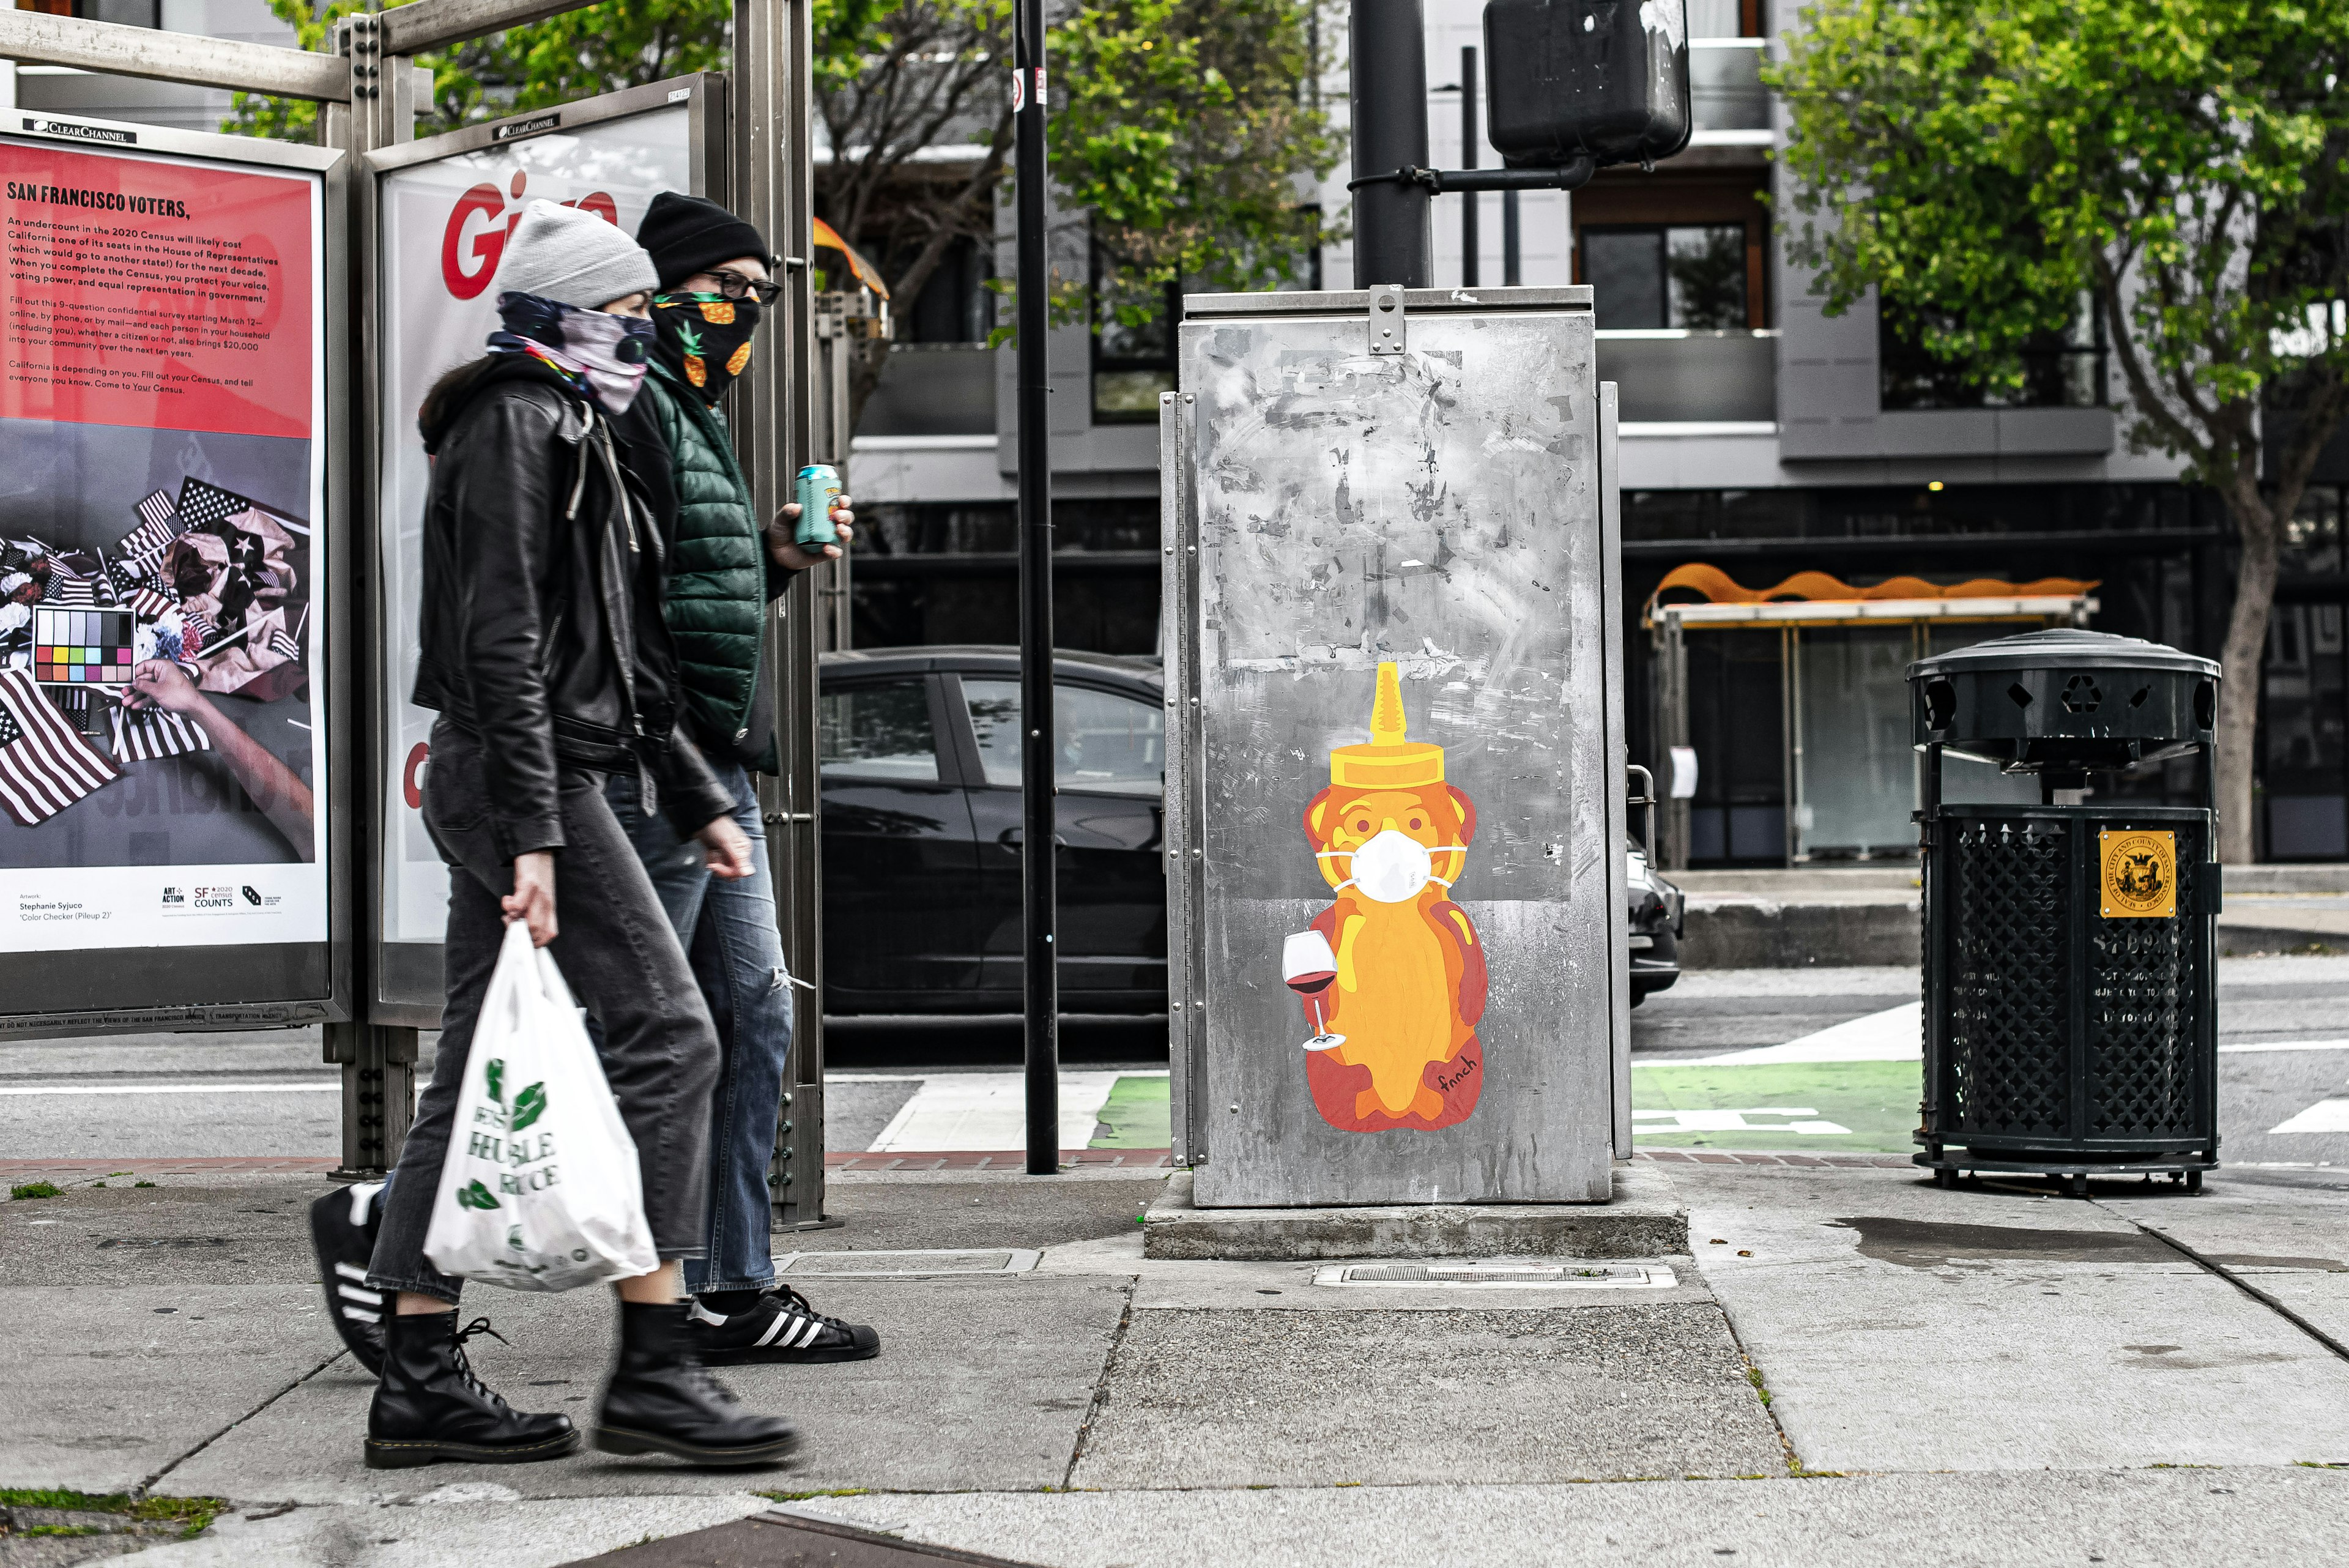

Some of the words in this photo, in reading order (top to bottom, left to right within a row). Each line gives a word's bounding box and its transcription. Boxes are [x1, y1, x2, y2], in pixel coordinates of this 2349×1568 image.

[7, 182, 36, 202] SAN
[41, 185, 125, 211] FRANCISCO
[129, 195, 190, 221] VOTERS,
[7, 216, 20, 225] An
[24, 220, 79, 231] undercount
[82, 224, 90, 232] in
[94, 226, 109, 234] the
[112, 228, 138, 237] 2020
[141, 231, 174, 241] Census
[177, 235, 193, 243] will
[196, 236, 219, 248] likely
[8, 230, 55, 242] California
[92, 238, 103, 247] its
[133, 243, 141, 251] in
[145, 244, 160, 253] the
[163, 246, 191, 256] House
[194, 249, 203, 257] of
[206, 251, 278, 265] Representatives
[8, 243, 40, 254] (which
[43, 249, 72, 257] would
[76, 252, 87, 260] go
[103, 255, 139, 264] another
[142, 258, 172, 268] state!)
[175, 260, 188, 269] for
[191, 262, 206, 271] the
[230, 266, 265, 276] decade.
[9, 257, 37, 266] When
[60, 264, 105, 274] complete
[108, 267, 123, 276] the
[126, 269, 162, 280] Census,
[184, 277, 217, 285] protect
[10, 272, 40, 283] voting
[43, 276, 75, 285] power,
[98, 281, 123, 290] equal
[127, 284, 195, 295] representation
[198, 288, 206, 297] in
[208, 292, 265, 302] government.
[10, 295, 22, 304] Fill
[59, 301, 104, 311] 9-question
[107, 307, 156, 316] confidential
[159, 312, 185, 320] survey
[187, 314, 217, 324] starting
[220, 316, 244, 324] March
[9, 310, 37, 318] online,
[41, 311, 51, 321] by
[53, 313, 82, 323] phone,
[95, 317, 105, 326] by
[230, 330, 270, 339] household
[9, 322, 52, 334] (including
[55, 327, 75, 335] you),
[78, 329, 112, 337] whether
[196, 338, 221, 349] brings
[223, 341, 258, 351] $20,000
[9, 335, 25, 343] into
[49, 340, 97, 350] community
[9, 360, 50, 370] California
[62, 365, 107, 376] depending
[191, 374, 222, 384] Census,
[68, 377, 92, 386] know.
[95, 379, 119, 388] Come
[133, 383, 150, 391] Your
[153, 384, 184, 393] Census.
[2118, 842, 2131, 852] AND
[2132, 839, 2159, 851] COUNTY
[20, 902, 56, 911] Stephanie
[58, 902, 83, 911] Syjuco
[195, 887, 209, 898] SF
[195, 899, 233, 907] COUNTS
[75, 912, 100, 920] (Pileup
[1438, 1055, 1477, 1092] fnnch
